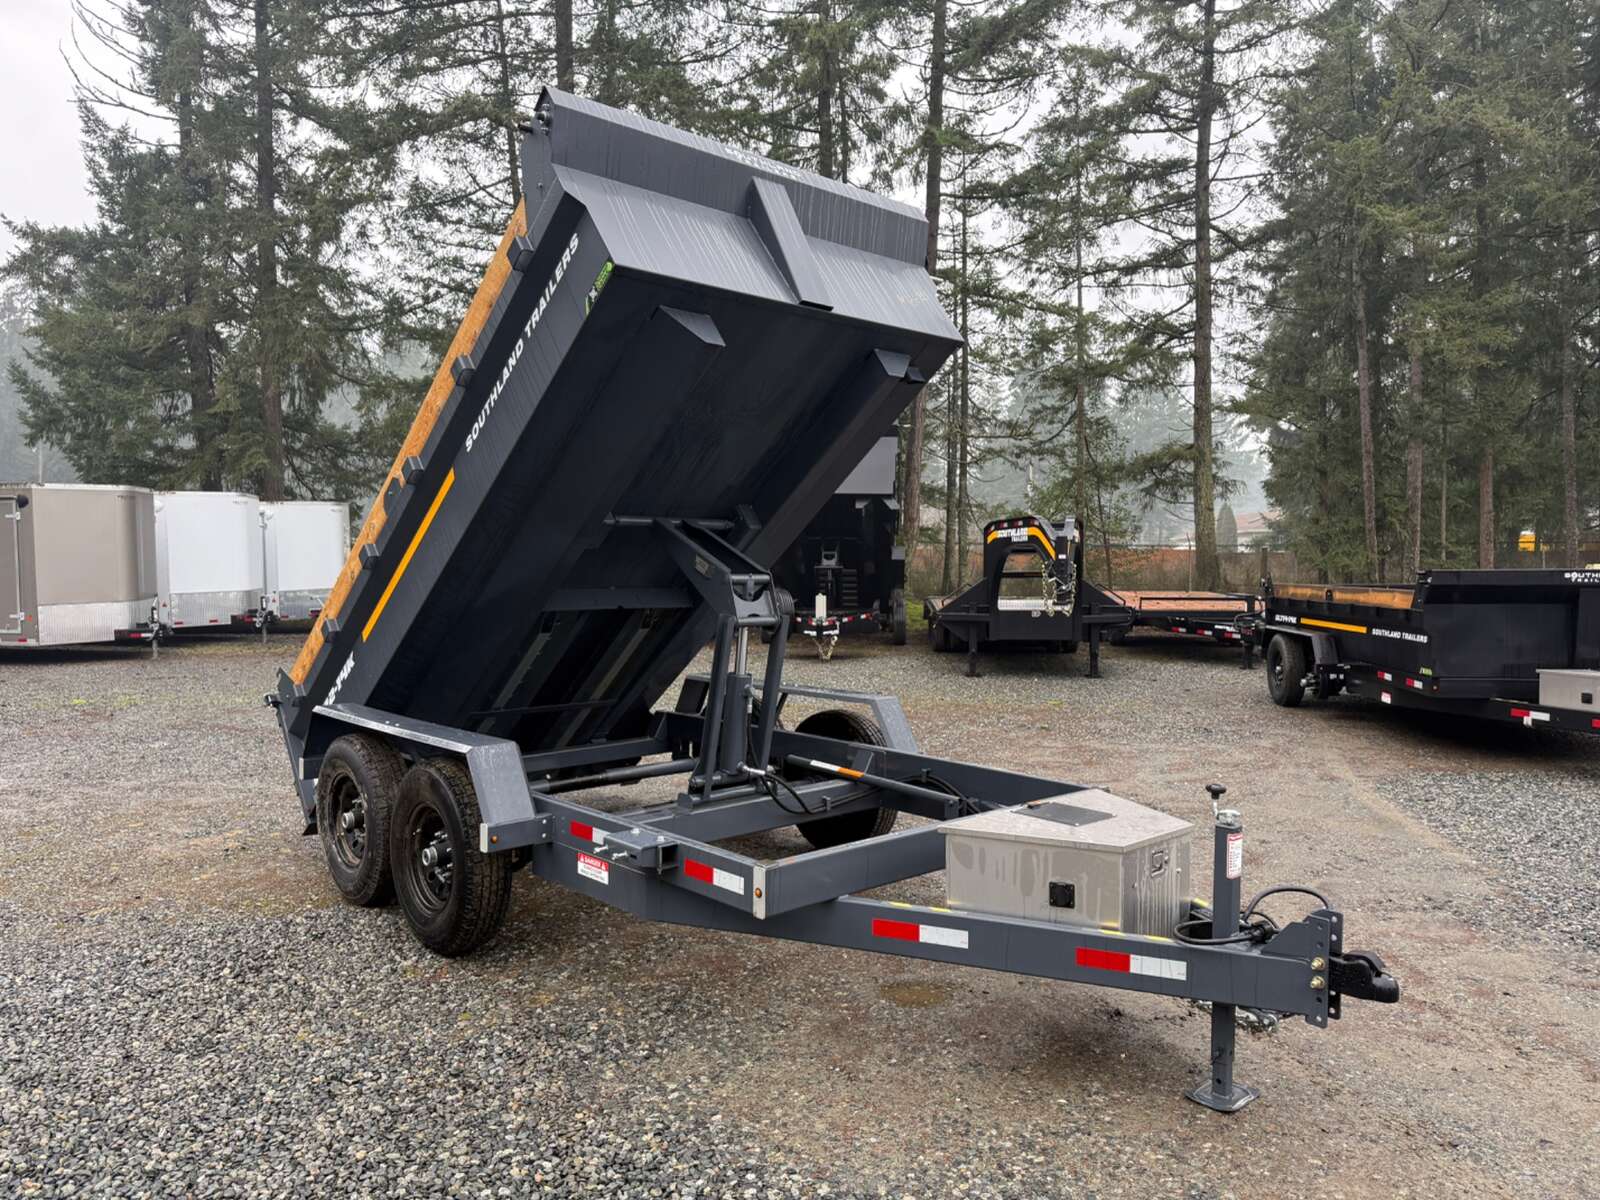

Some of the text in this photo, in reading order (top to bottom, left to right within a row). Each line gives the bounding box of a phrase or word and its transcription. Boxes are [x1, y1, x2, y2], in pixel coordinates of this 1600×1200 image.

[465, 232, 580, 453] SOUTHLAND TRAILERS
[1372, 628, 1401, 639] SOUTHLAND
[1402, 632, 1428, 643] TRAILERS
